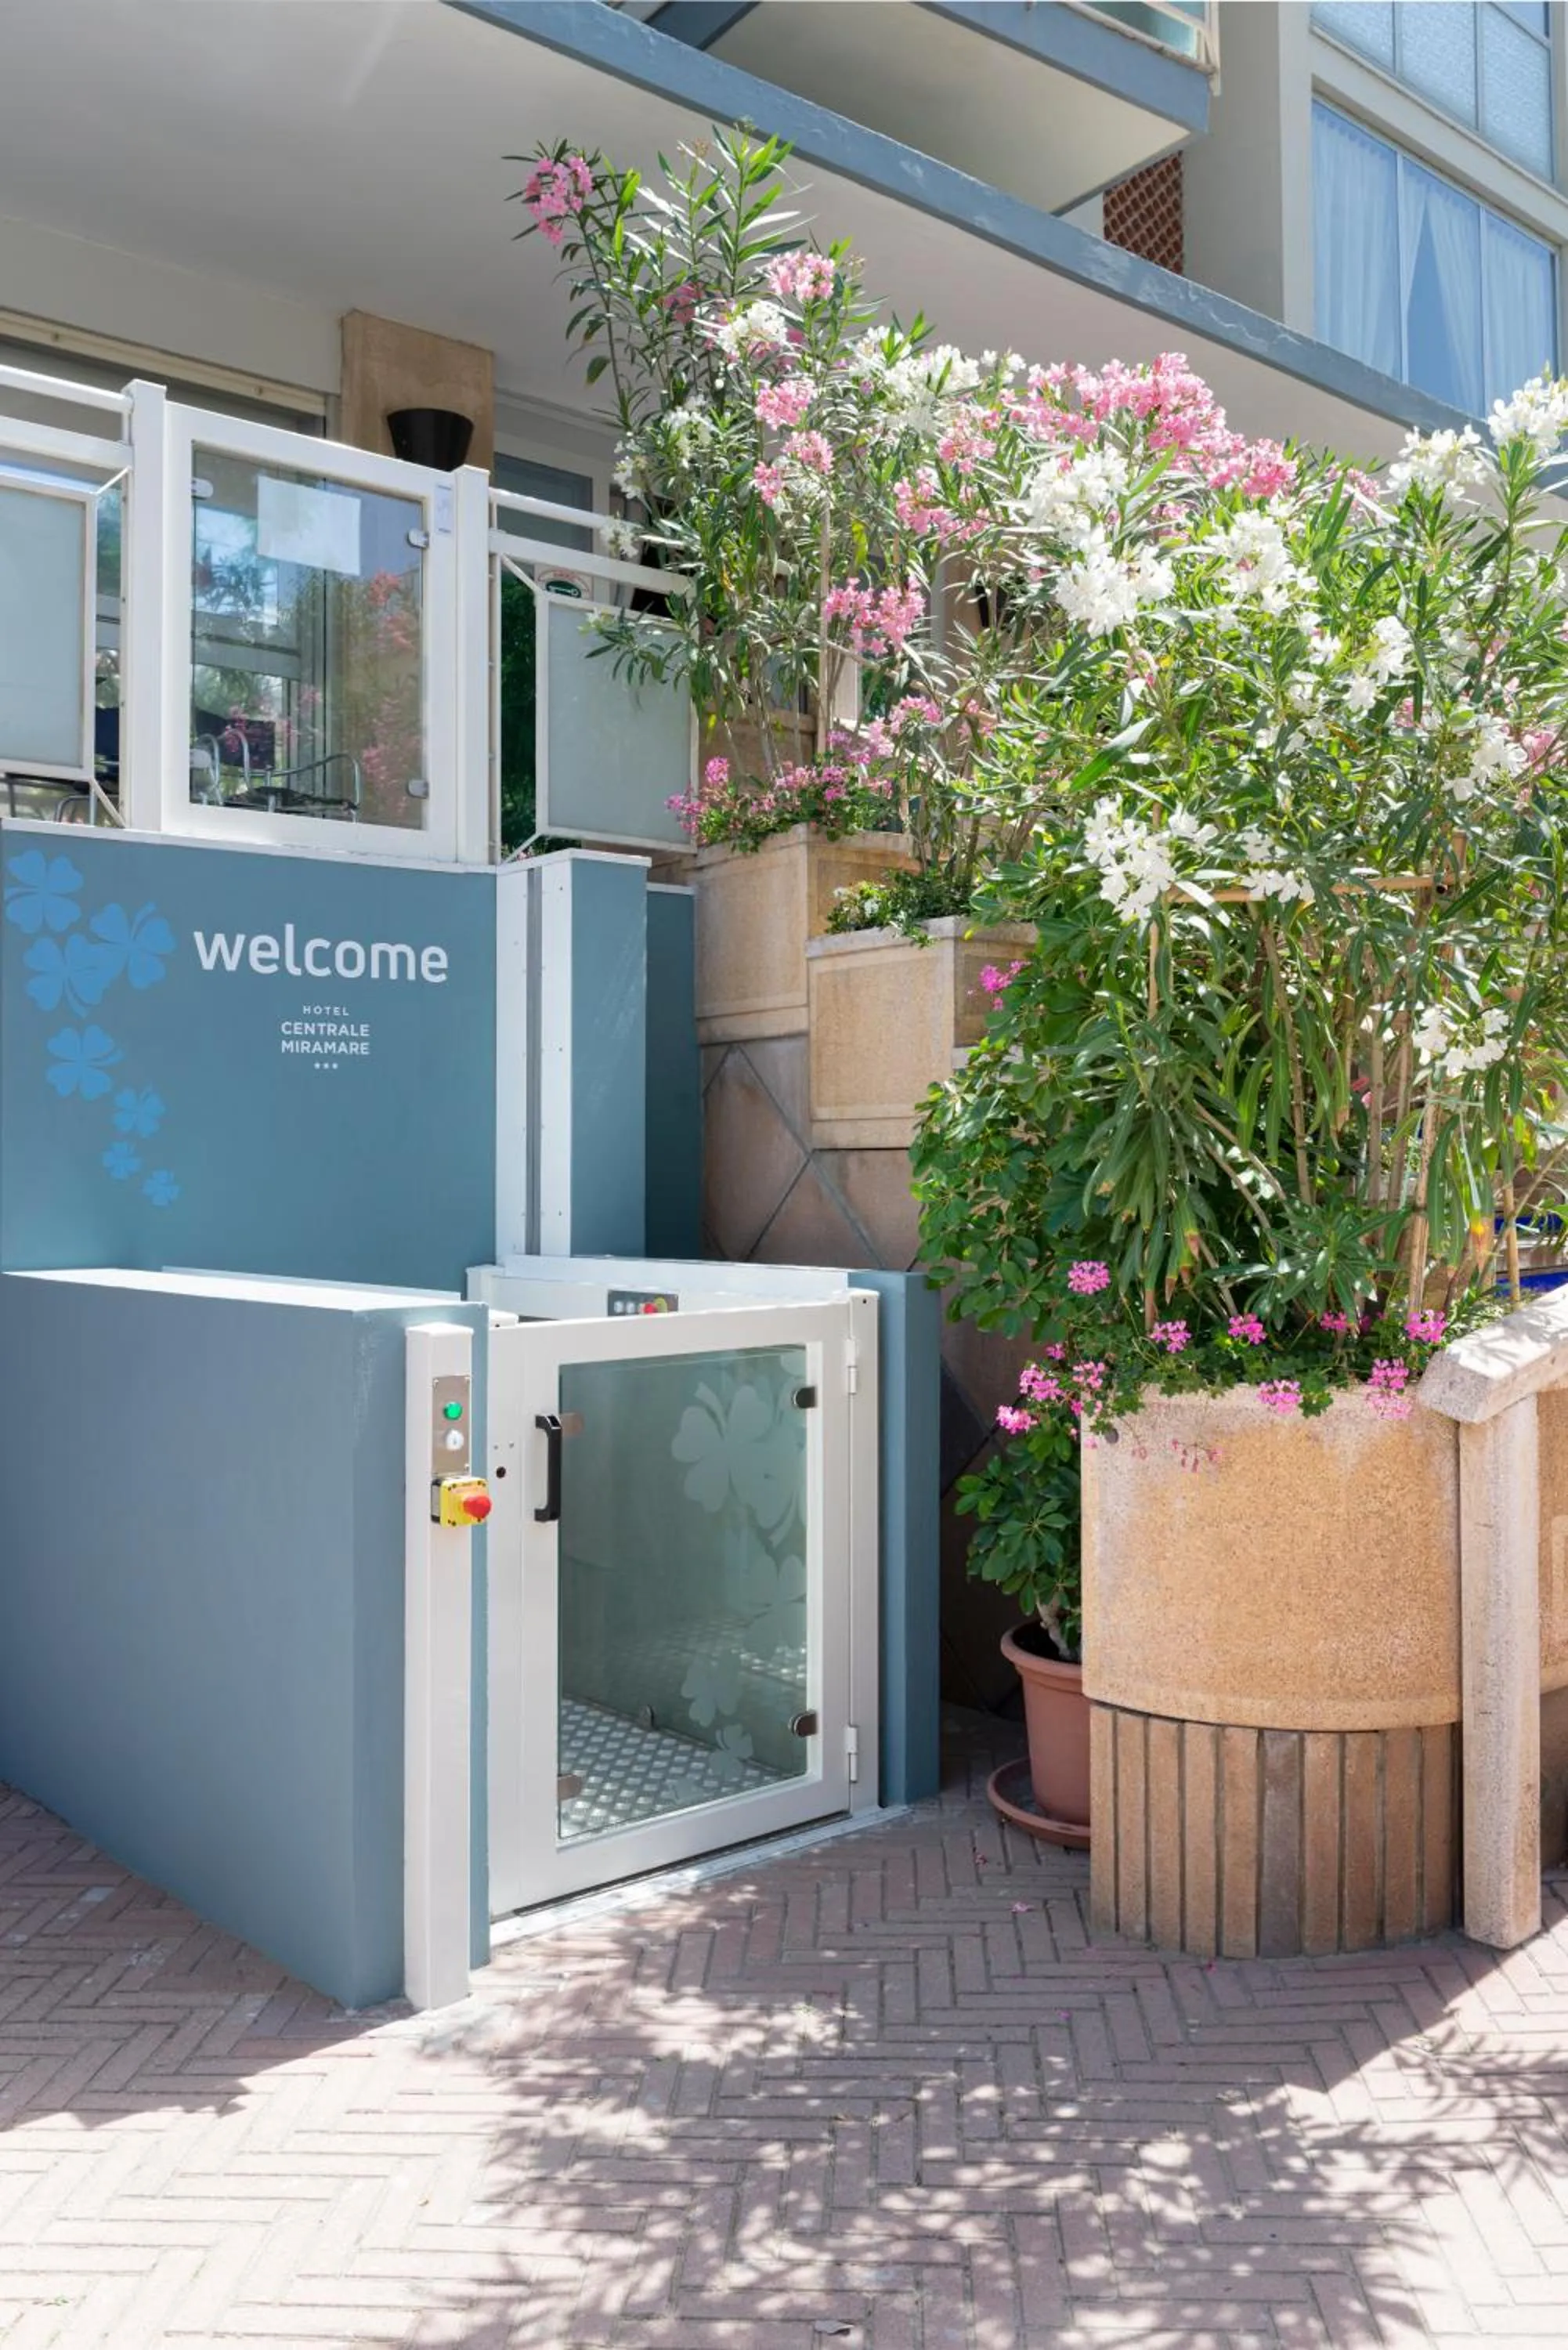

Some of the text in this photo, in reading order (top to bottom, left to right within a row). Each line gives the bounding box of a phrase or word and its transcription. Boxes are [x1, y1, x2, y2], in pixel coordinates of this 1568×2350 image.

[193, 923, 448, 983] welcome
[302, 1005, 349, 1016] HOTEL
[281, 1021, 370, 1037] CENTRALE
[281, 1039, 370, 1055] MIRAMARE
